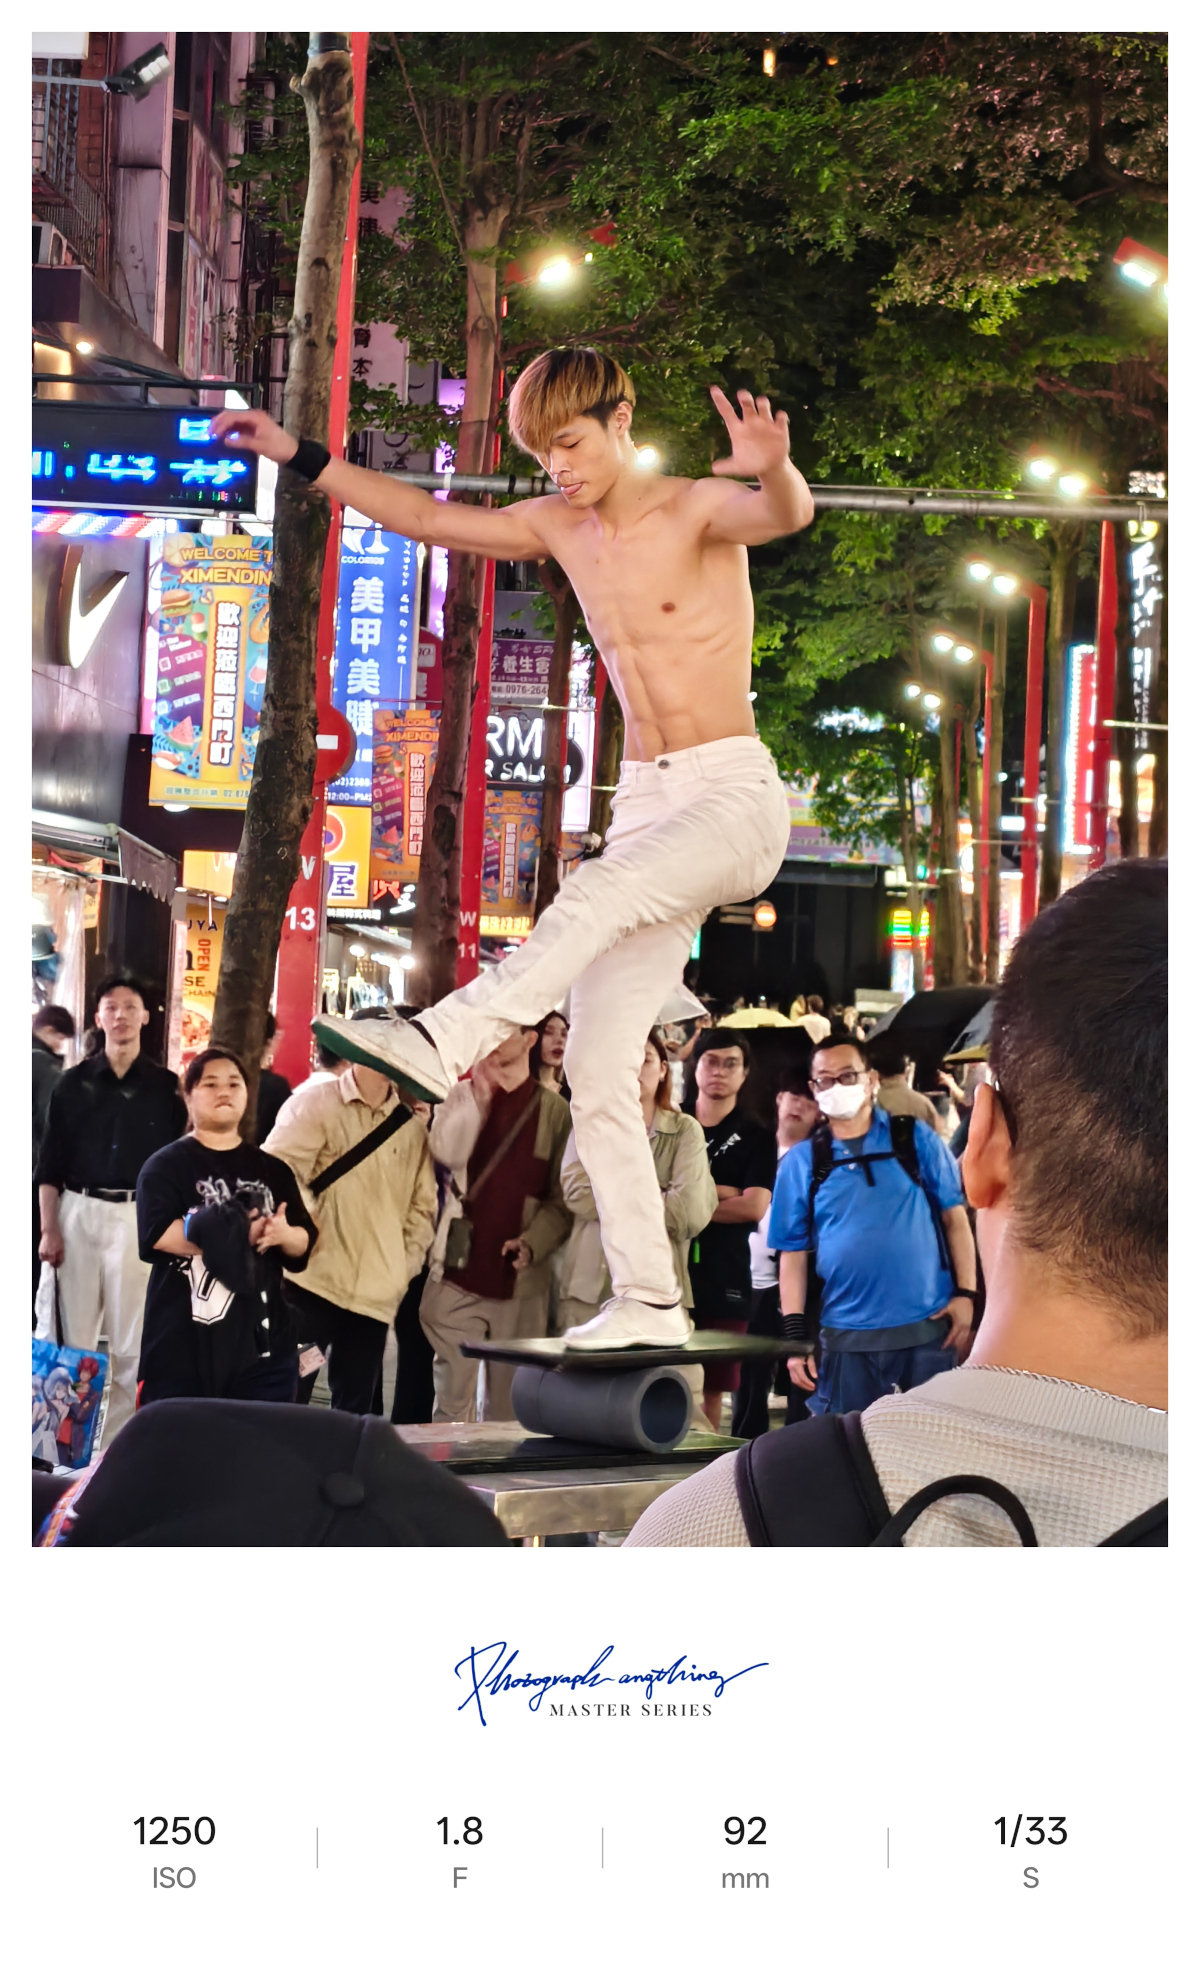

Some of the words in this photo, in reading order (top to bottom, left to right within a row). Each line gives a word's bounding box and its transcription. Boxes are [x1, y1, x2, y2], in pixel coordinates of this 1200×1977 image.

[180, 547, 261, 561] WELCOME
[345, 576, 386, 736] 美甲美睫
[285, 906, 316, 931] 13
[459, 911, 477, 927] W
[197, 939, 211, 971] OPEN
[457, 943, 477, 958] 11
